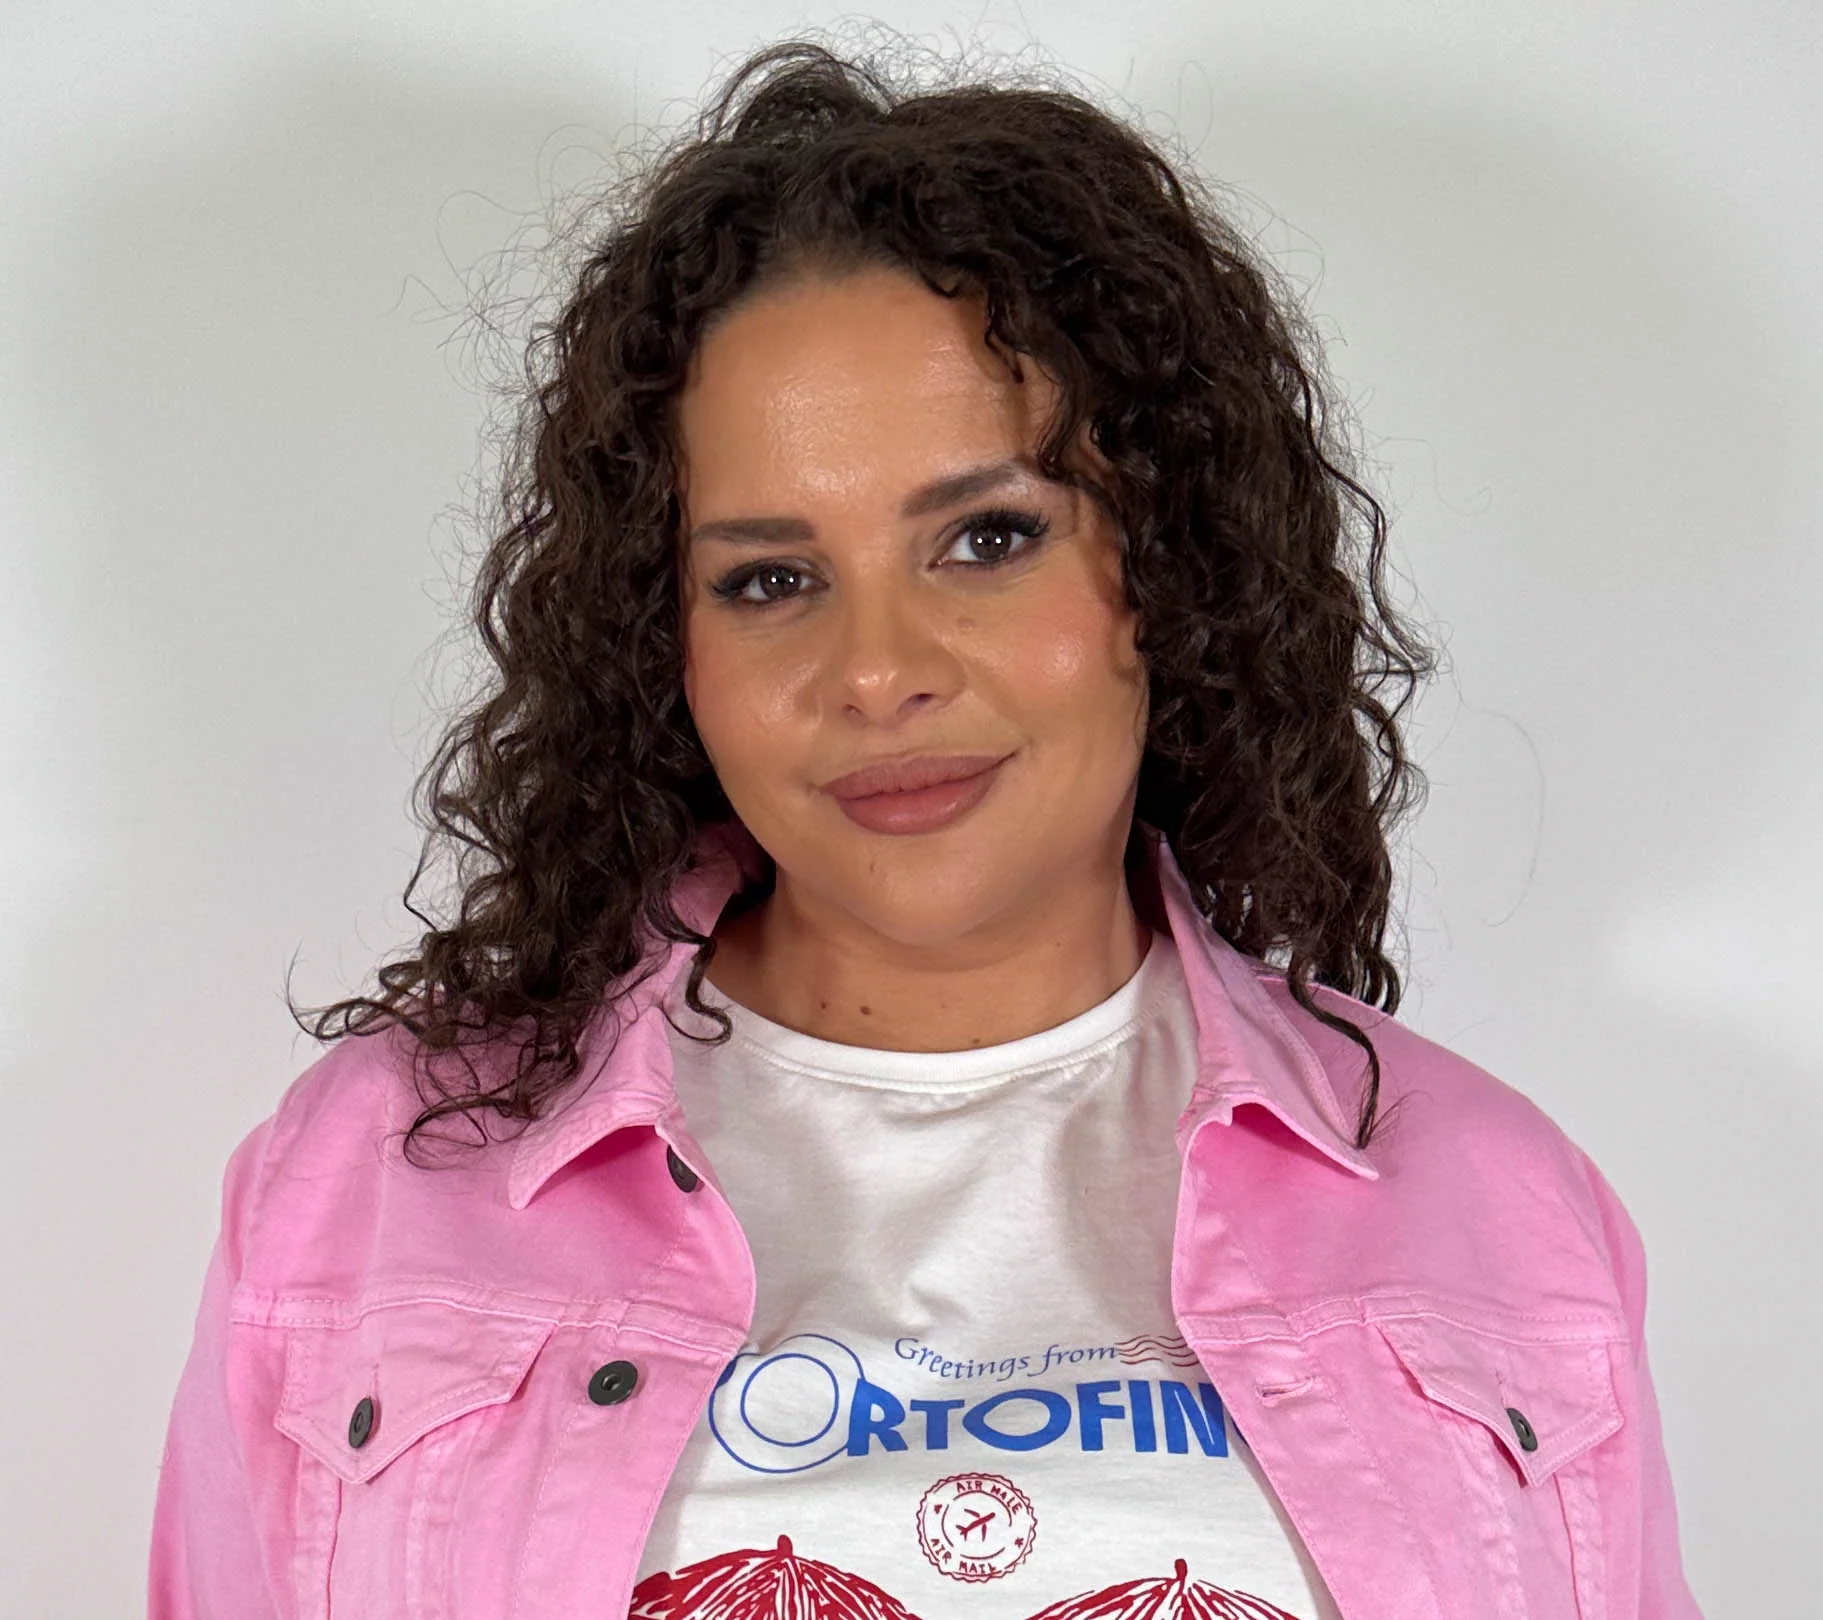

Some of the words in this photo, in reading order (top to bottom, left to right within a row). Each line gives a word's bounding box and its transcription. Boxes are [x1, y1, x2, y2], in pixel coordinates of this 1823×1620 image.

[894, 1337, 1031, 1382] Greetings
[1028, 1344, 1117, 1378] from
[708, 1333, 1250, 1474] ORTOFIN
[955, 1480, 983, 1493] AIR
[959, 1560, 998, 1575] MAIL
